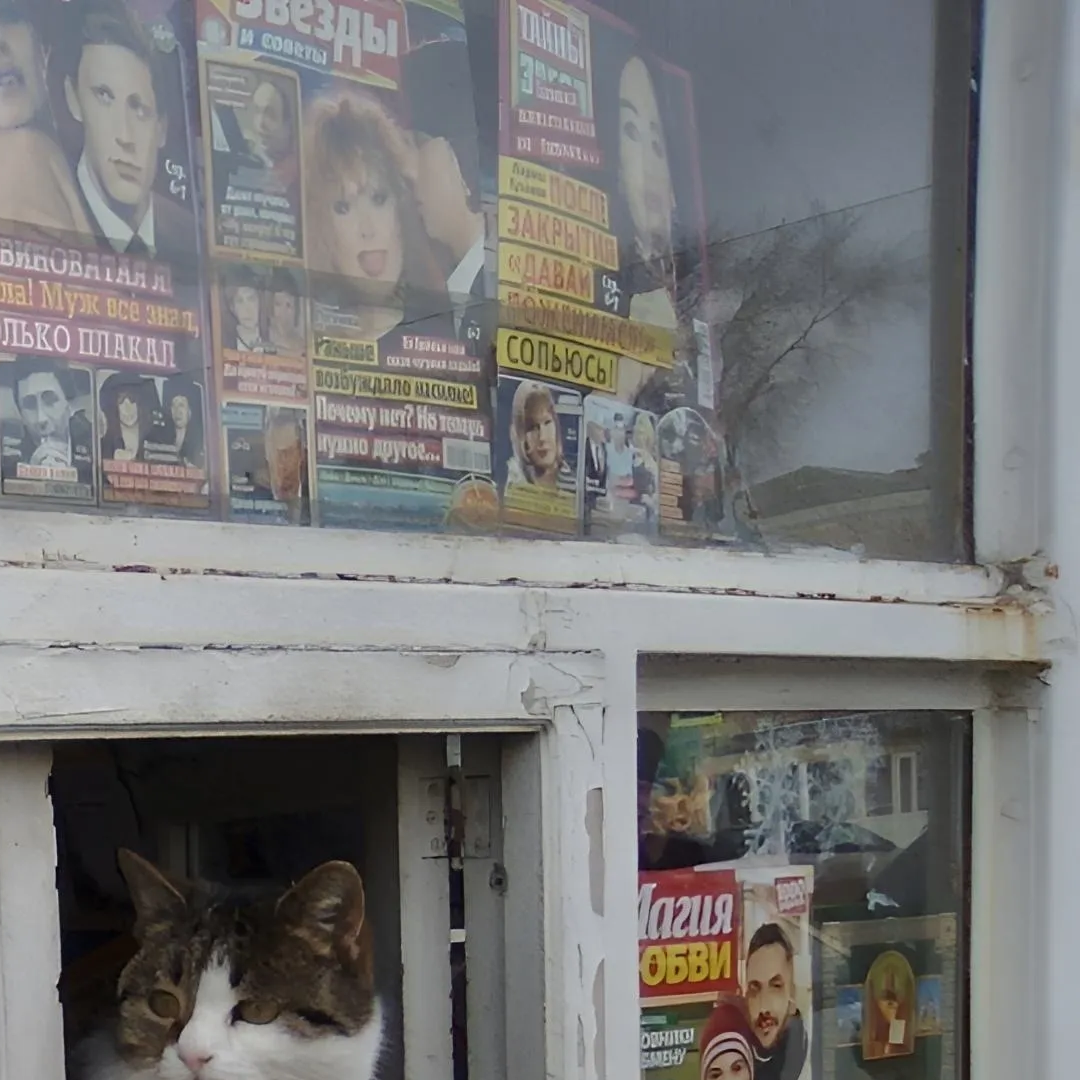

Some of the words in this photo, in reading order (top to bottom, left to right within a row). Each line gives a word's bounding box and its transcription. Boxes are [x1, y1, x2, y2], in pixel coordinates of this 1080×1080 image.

[41, 281, 102, 319] Муж
[78, 328, 176, 368] ПЛАКАЛ
[316, 396, 376, 431] Почему
